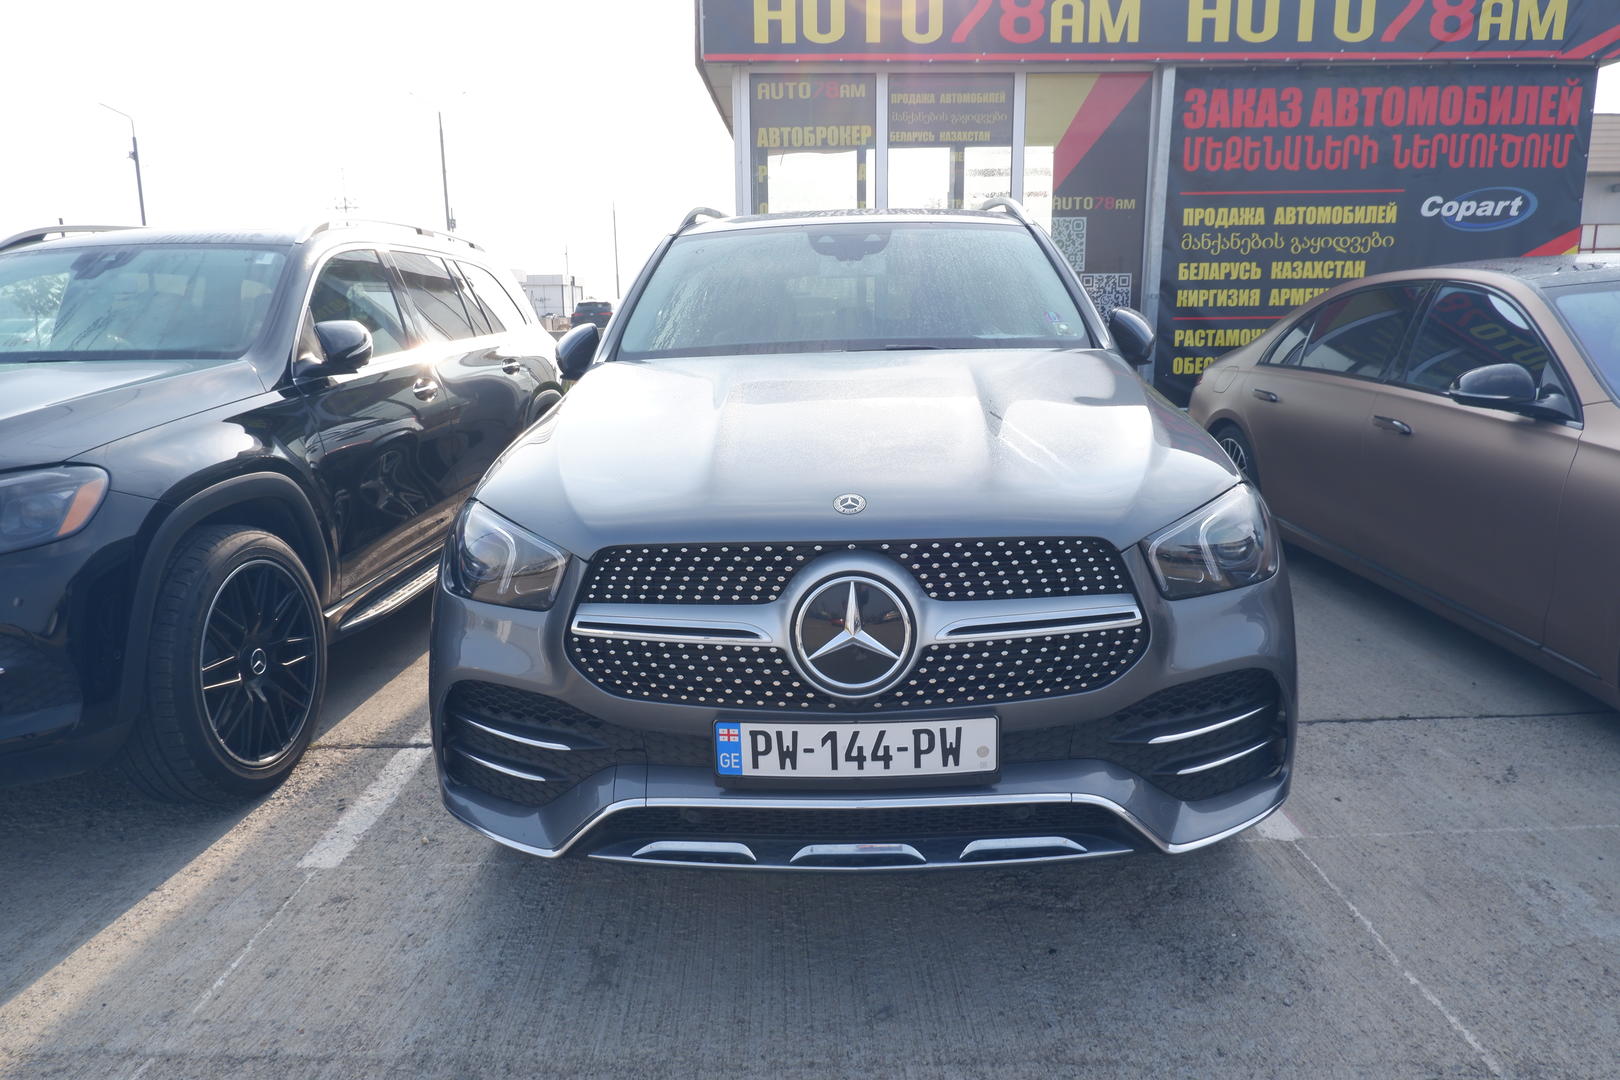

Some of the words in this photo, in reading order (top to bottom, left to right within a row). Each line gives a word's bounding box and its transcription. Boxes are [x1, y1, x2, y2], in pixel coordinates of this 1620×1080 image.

[757, 81, 866, 100] AUTO78AM
[891, 93, 936, 105] ПРОДАЖА
[940, 91, 1007, 104] АВТОМОБИЛЕЙ
[1183, 87, 1304, 129] ЗАКАЗ
[1309, 77, 1584, 127] АВТОМОБИЛЕЙ
[756, 125, 873, 148] АВТОБРОКЕР
[889, 131, 936, 142] БЕЛАРУСЬ
[939, 131, 991, 142] КАЗАХСТАН
[1183, 134, 1379, 172] ՄԵՔԵՆԱՆԵՐԻ
[1392, 133, 1575, 169] ՆԵՐՄՈՒԾՈՒՄ
[1183, 207, 1266, 229] ПРОДАЖА
[1273, 202, 1398, 226] АВТОМОБИЛЕЙ
[1420, 195, 1523, 221] Copart
[1181, 232, 1285, 255] მანქანების
[1290, 231, 1395, 255] გაყიდვები
[1178, 261, 1262, 281] БЕЛАРУСЬ
[1270, 260, 1367, 280] КАЗАХСТАН
[1176, 288, 1261, 308] КИРГИЗИЯ
[719, 753, 741, 769] GE
[748, 726, 963, 771] PW-144-PW
